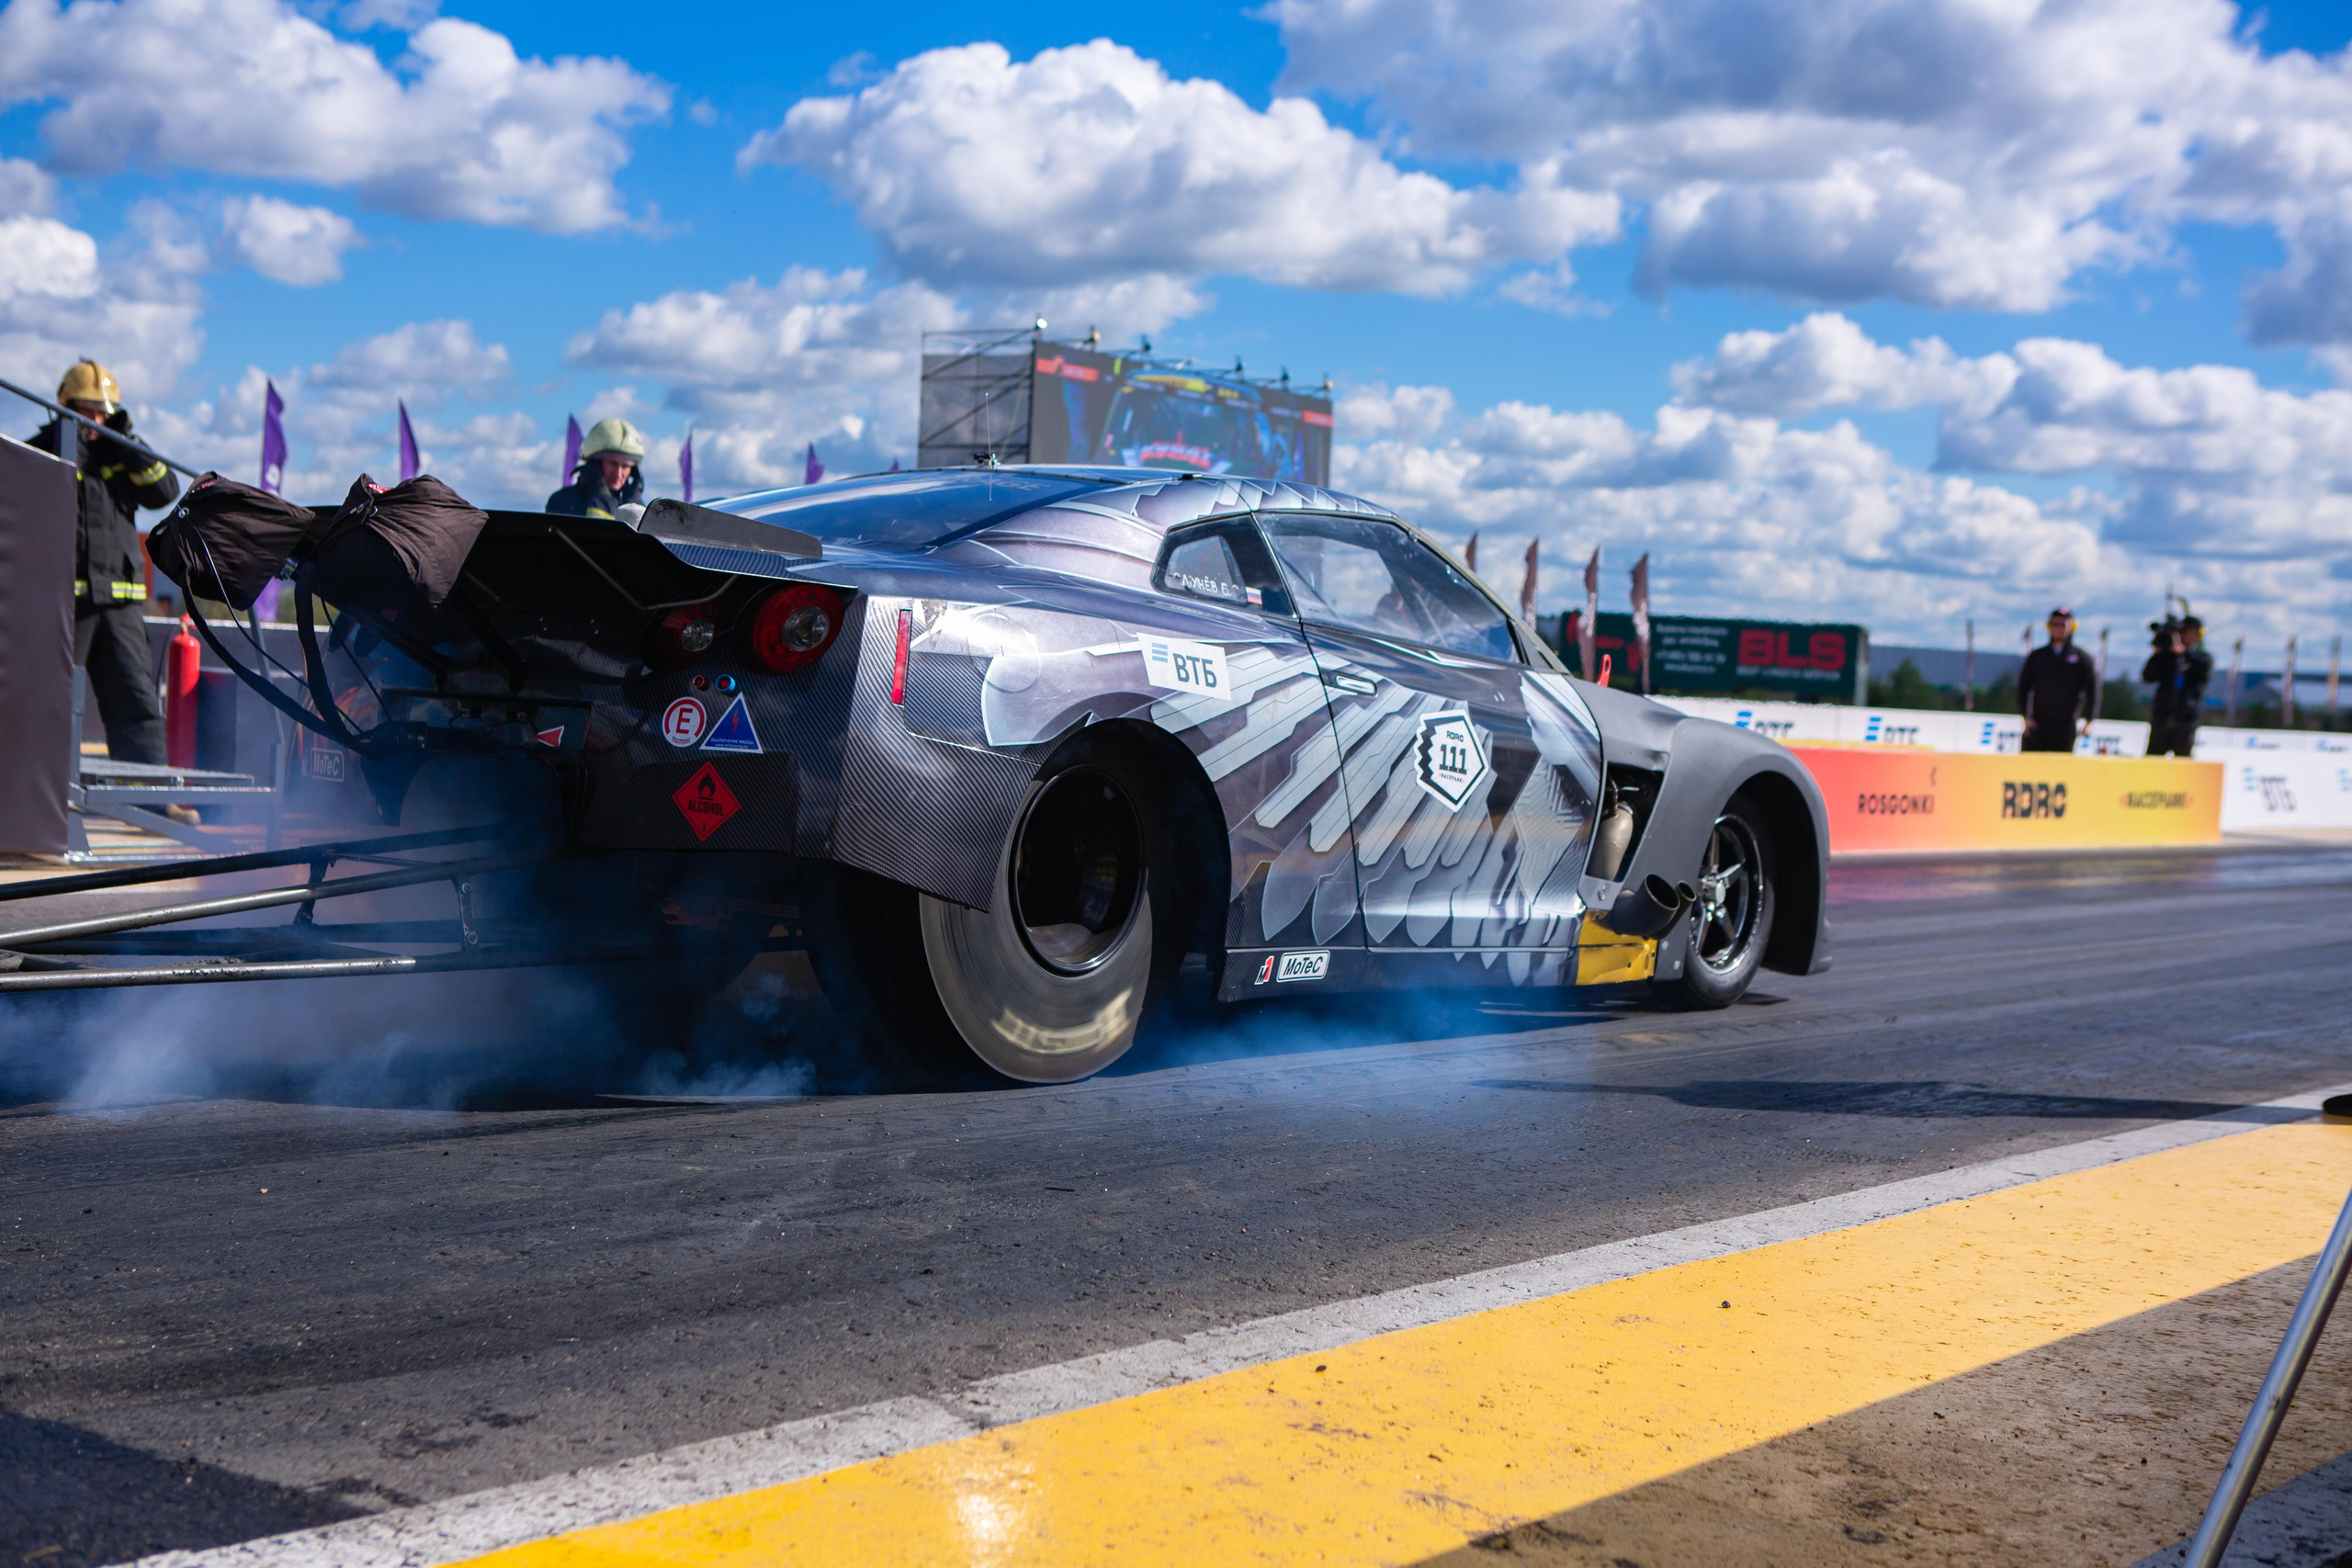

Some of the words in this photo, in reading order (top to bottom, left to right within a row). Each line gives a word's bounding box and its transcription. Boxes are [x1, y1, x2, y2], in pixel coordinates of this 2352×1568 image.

[1182, 573, 1218, 593] ЛУНЁВ
[1739, 629, 1847, 671] BLS
[1172, 652, 1218, 688] ВТБ
[675, 707, 693, 734] E
[313, 754, 340, 777] MoTeC
[1439, 743, 1468, 775] 111
[1441, 773, 1464, 783] RACEPARK
[687, 799, 725, 817] ALCOHOL
[1857, 793, 1935, 816] ROSGONKI
[2002, 781, 2068, 820] RDRC
[2126, 791, 2188, 809] RACEPARK
[700, 822, 707, 832] 3
[1283, 956, 1324, 976] MoTeC
